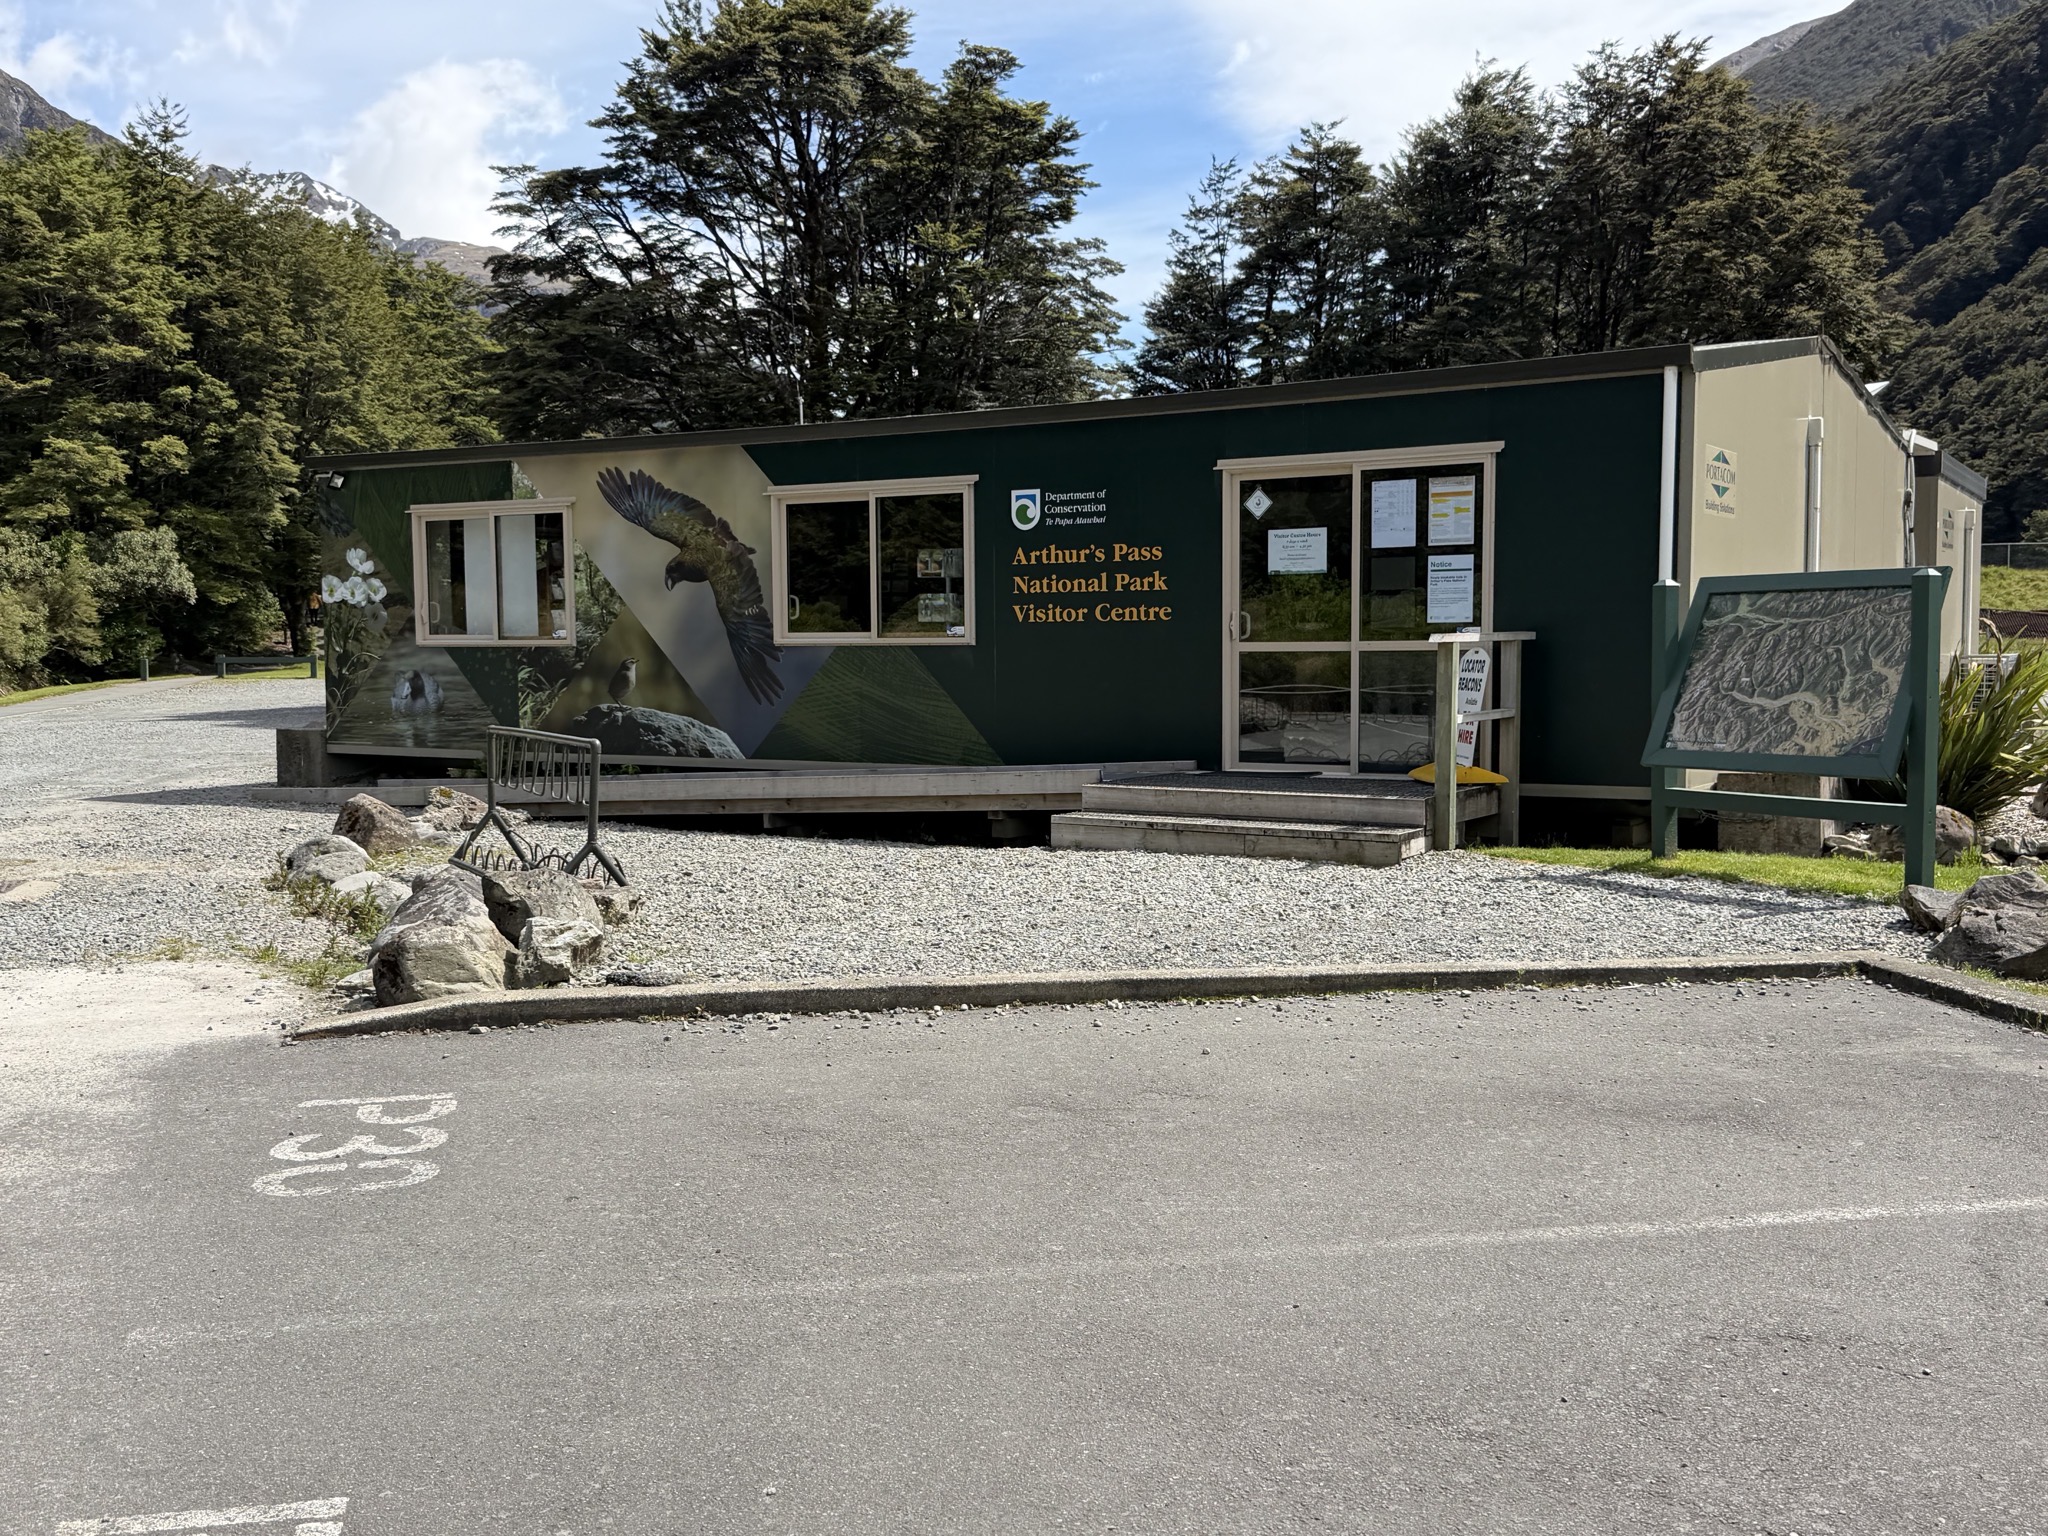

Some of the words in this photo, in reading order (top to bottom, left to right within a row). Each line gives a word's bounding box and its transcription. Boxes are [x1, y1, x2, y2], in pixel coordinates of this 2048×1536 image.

[1705, 463, 1736, 485] PORTACOM
[1045, 491, 1095, 503] Department
[1096, 489, 1107, 499] of
[1044, 502, 1107, 514] Conservation
[1045, 518, 1054, 526] Te
[1054, 517, 1073, 527] Papa
[1012, 544, 1105, 565] Arthur's
[1112, 543, 1163, 562] Pass
[1012, 572, 1108, 594] National
[1115, 570, 1168, 592] Park
[1012, 603, 1088, 623] Visitor
[1094, 603, 1172, 622] Centre
[1461, 658, 1486, 674] LOCATOR
[1458, 677, 1483, 693] BEACONS
[1457, 729, 1474, 745] HIRE
[251, 1092, 458, 1197] P30
